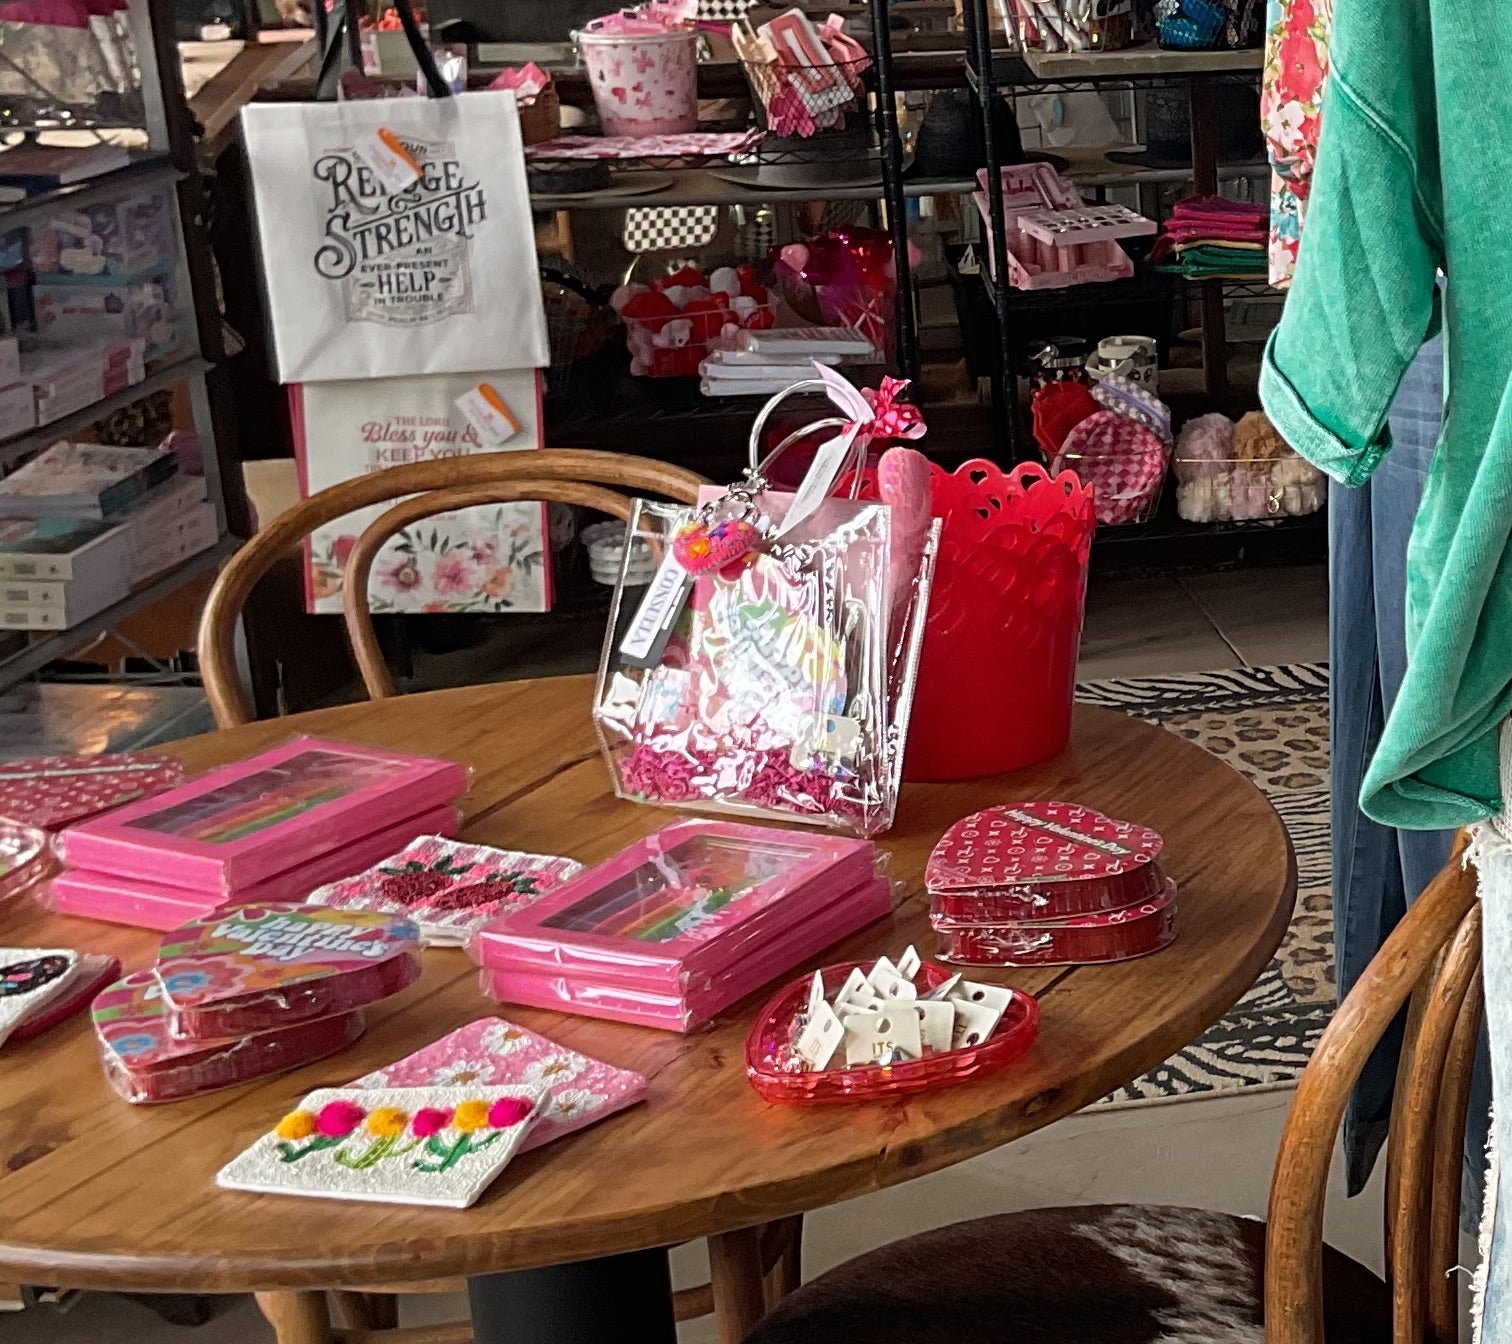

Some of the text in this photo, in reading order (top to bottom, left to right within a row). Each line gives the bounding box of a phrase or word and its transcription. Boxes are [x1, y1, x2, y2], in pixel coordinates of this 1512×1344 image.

[313, 155, 465, 216] REGE
[314, 190, 488, 280] STRENGTH
[390, 293, 444, 304] TROUBLE
[361, 421, 416, 443] Bless
[413, 428, 458, 451] you
[630, 568, 680, 645] CONSUELA
